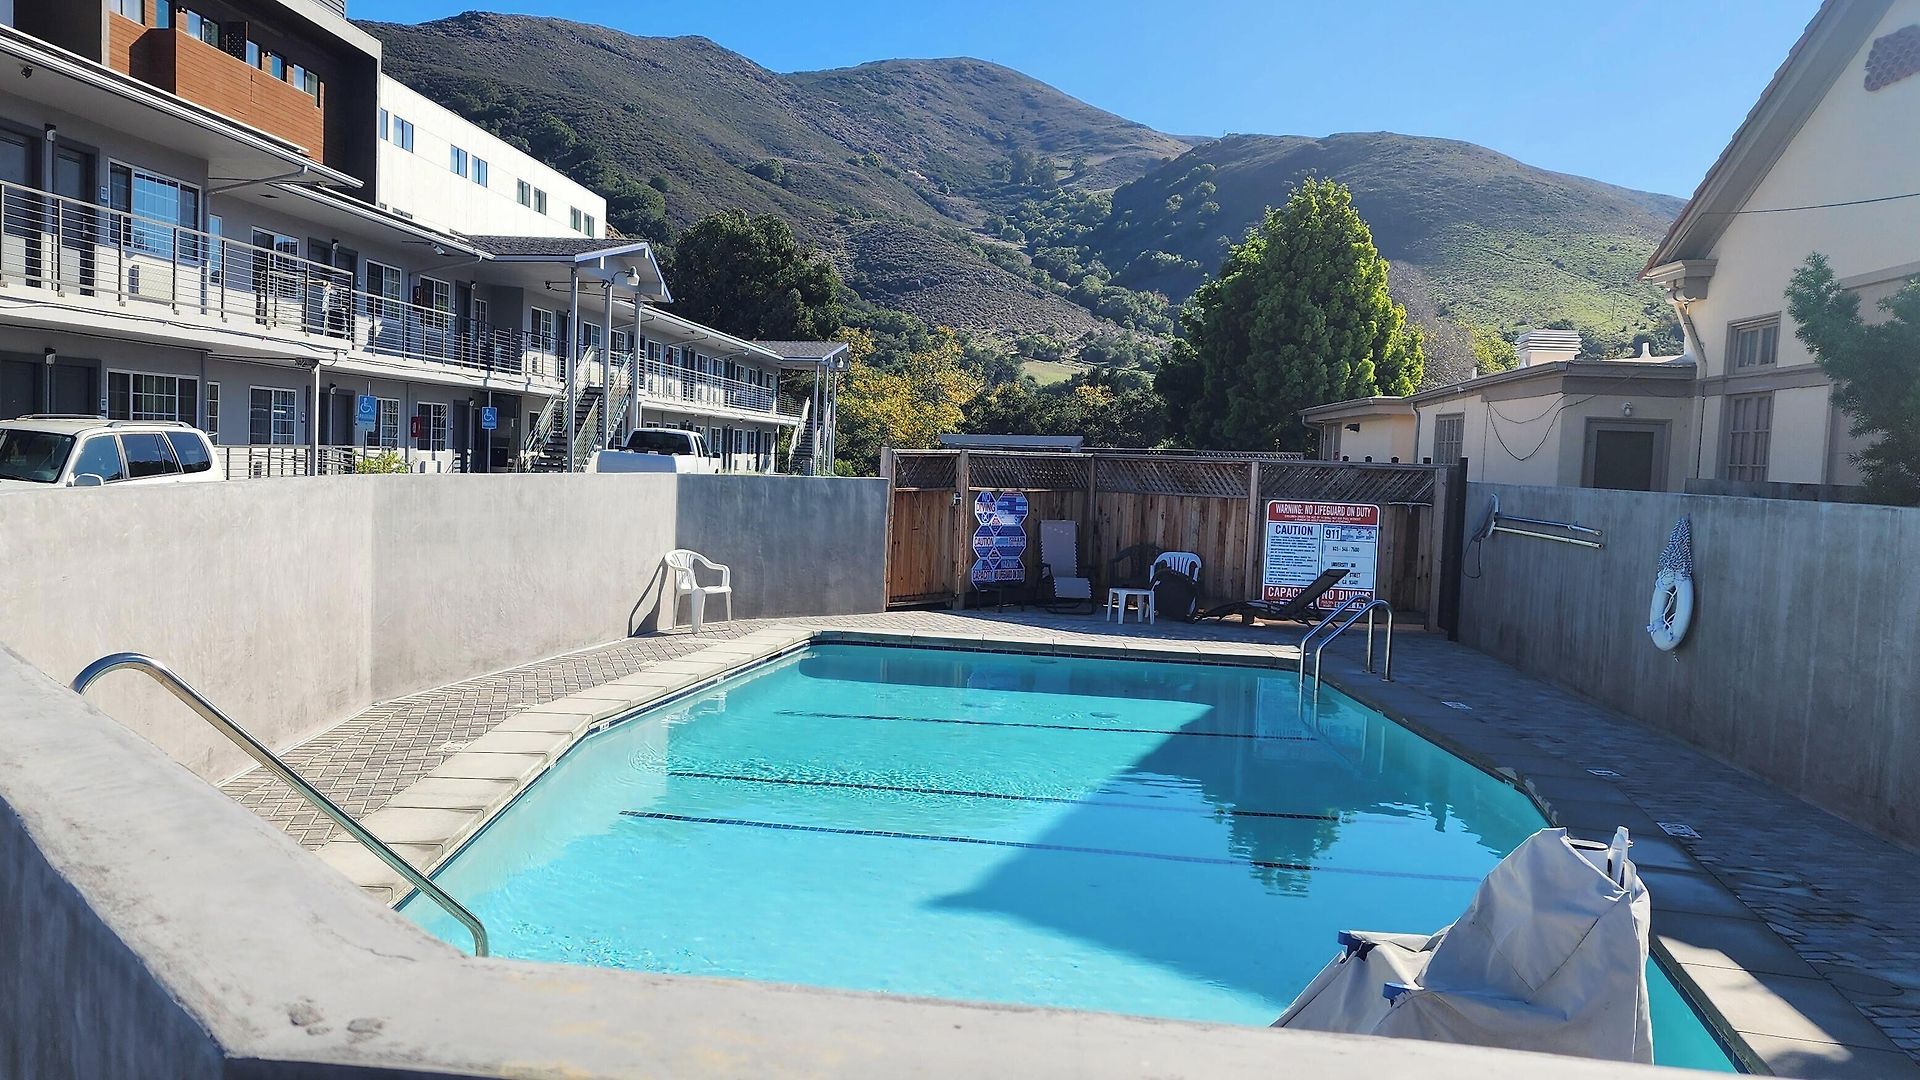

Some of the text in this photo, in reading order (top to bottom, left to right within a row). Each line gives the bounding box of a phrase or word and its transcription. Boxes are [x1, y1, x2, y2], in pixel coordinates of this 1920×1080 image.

[982, 493, 990, 502] NO
[976, 502, 995, 511] DIVING
[1276, 504, 1371, 517] WARNING: NO LIFEGUARD ON DUTY
[1275, 524, 1313, 536] CAUTION
[1326, 529, 1340, 539] 911
[1322, 590, 1334, 600] NO
